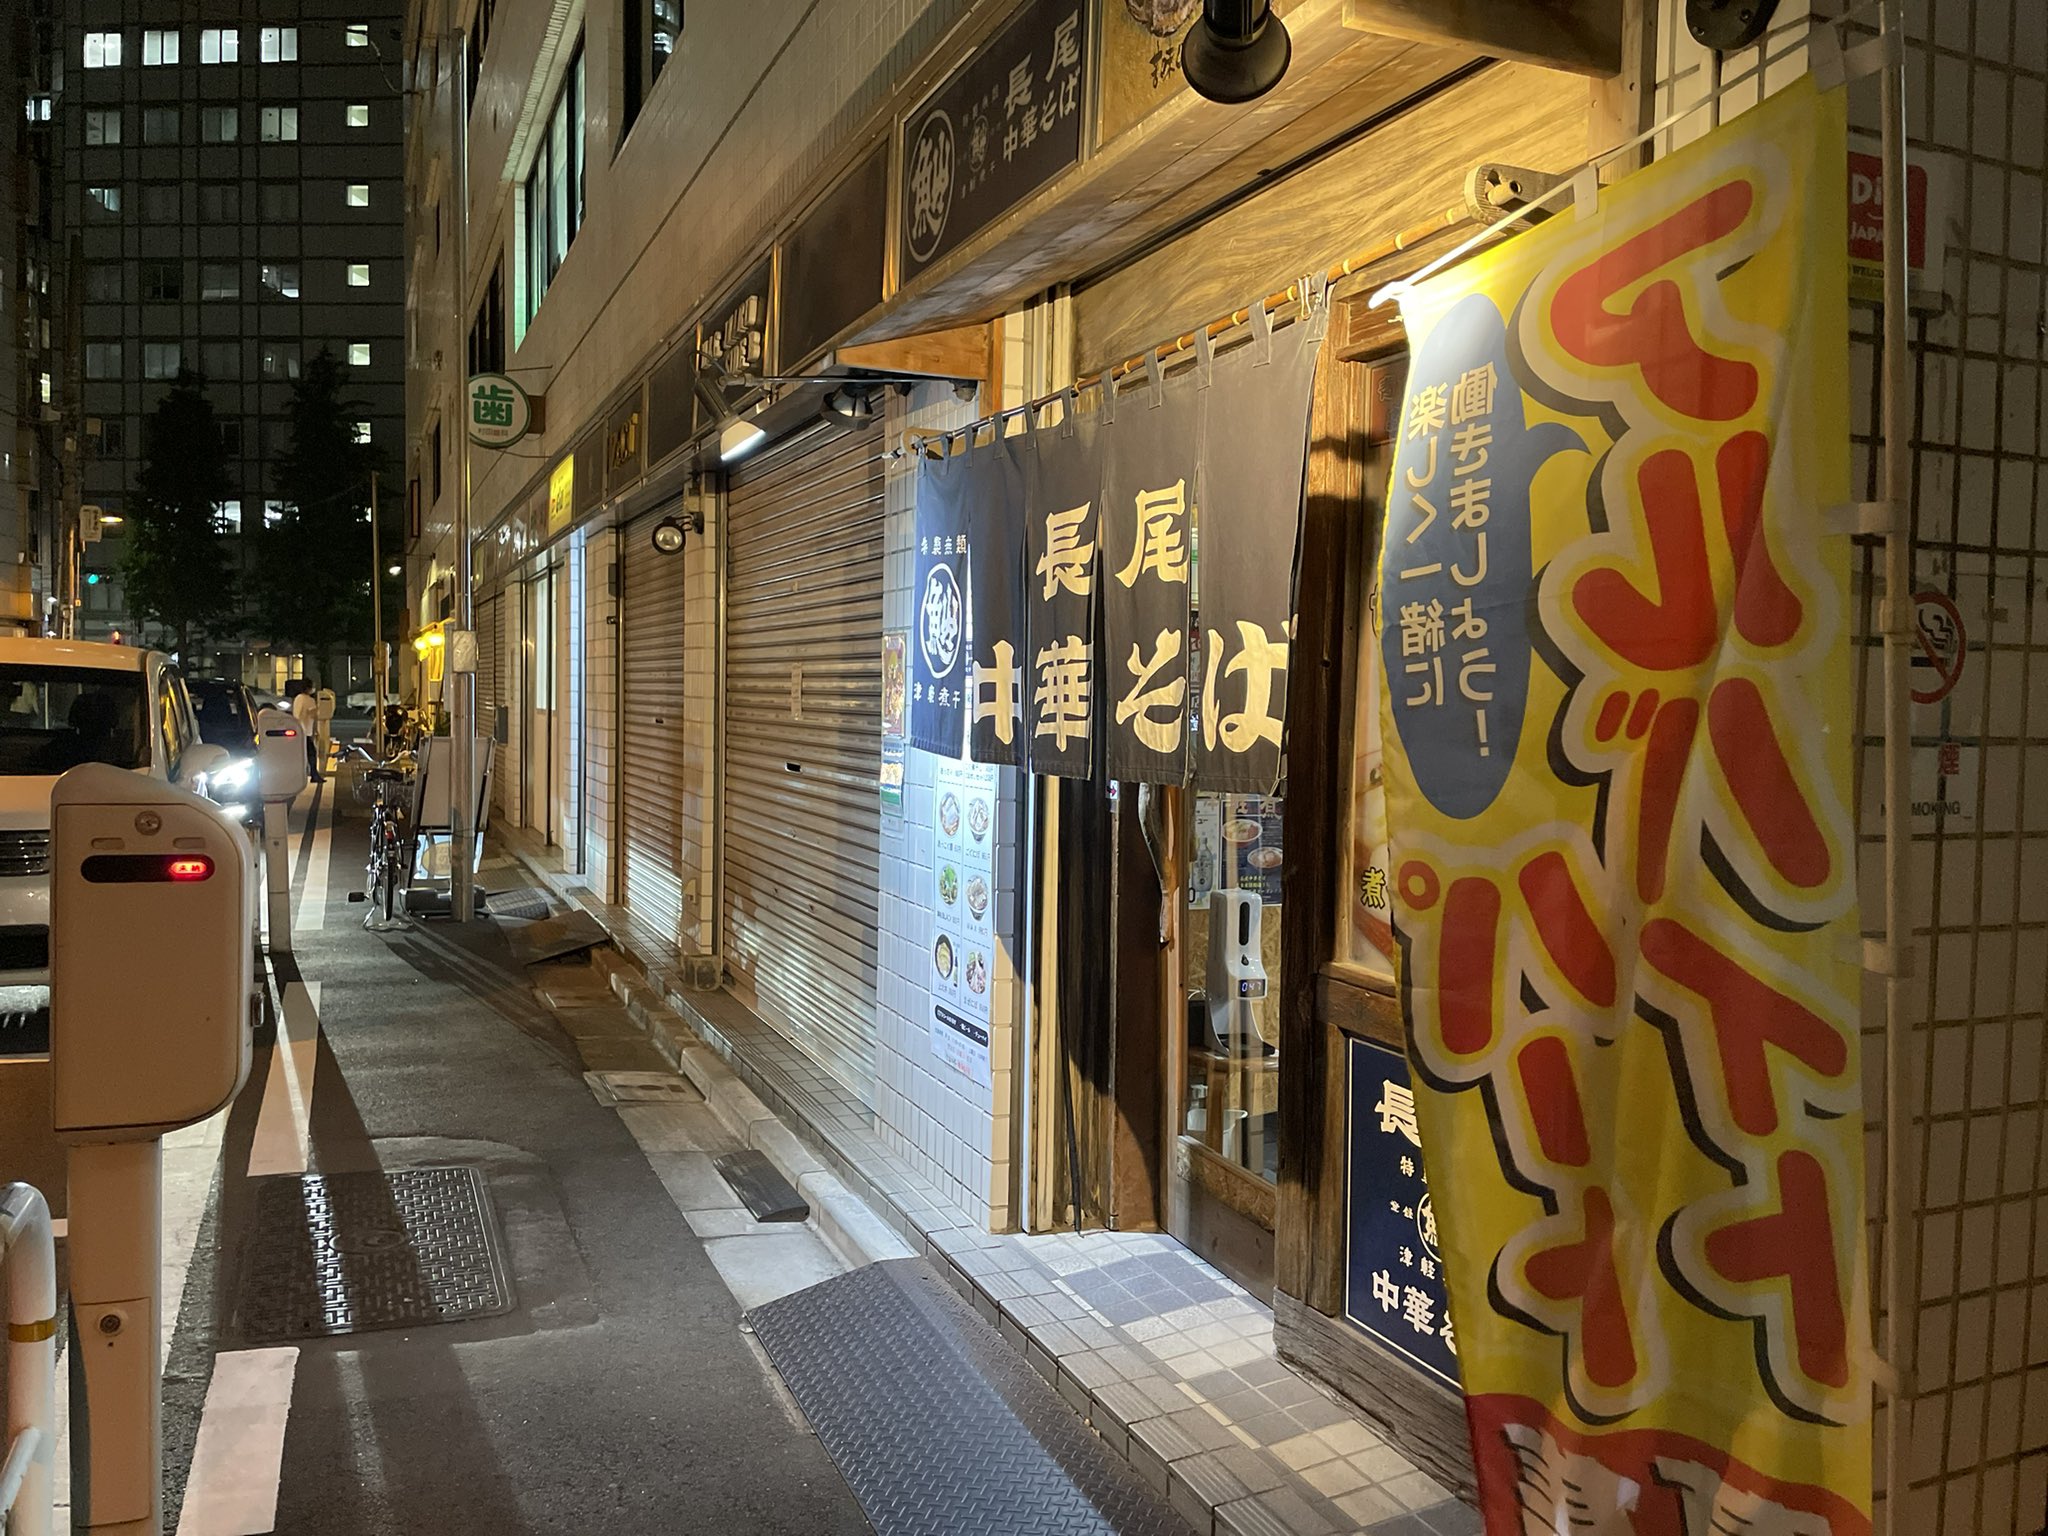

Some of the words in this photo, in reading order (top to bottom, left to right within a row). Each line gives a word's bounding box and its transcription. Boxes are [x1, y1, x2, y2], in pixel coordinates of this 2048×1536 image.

[1002, 65, 1081, 163] 中華そば
[1003, 9, 1080, 121] 長尾
[472, 384, 515, 427] 歯
[1036, 478, 1191, 602] 長尾
[972, 620, 1290, 754] 中華そば
[1911, 800, 1961, 817] MOKING
